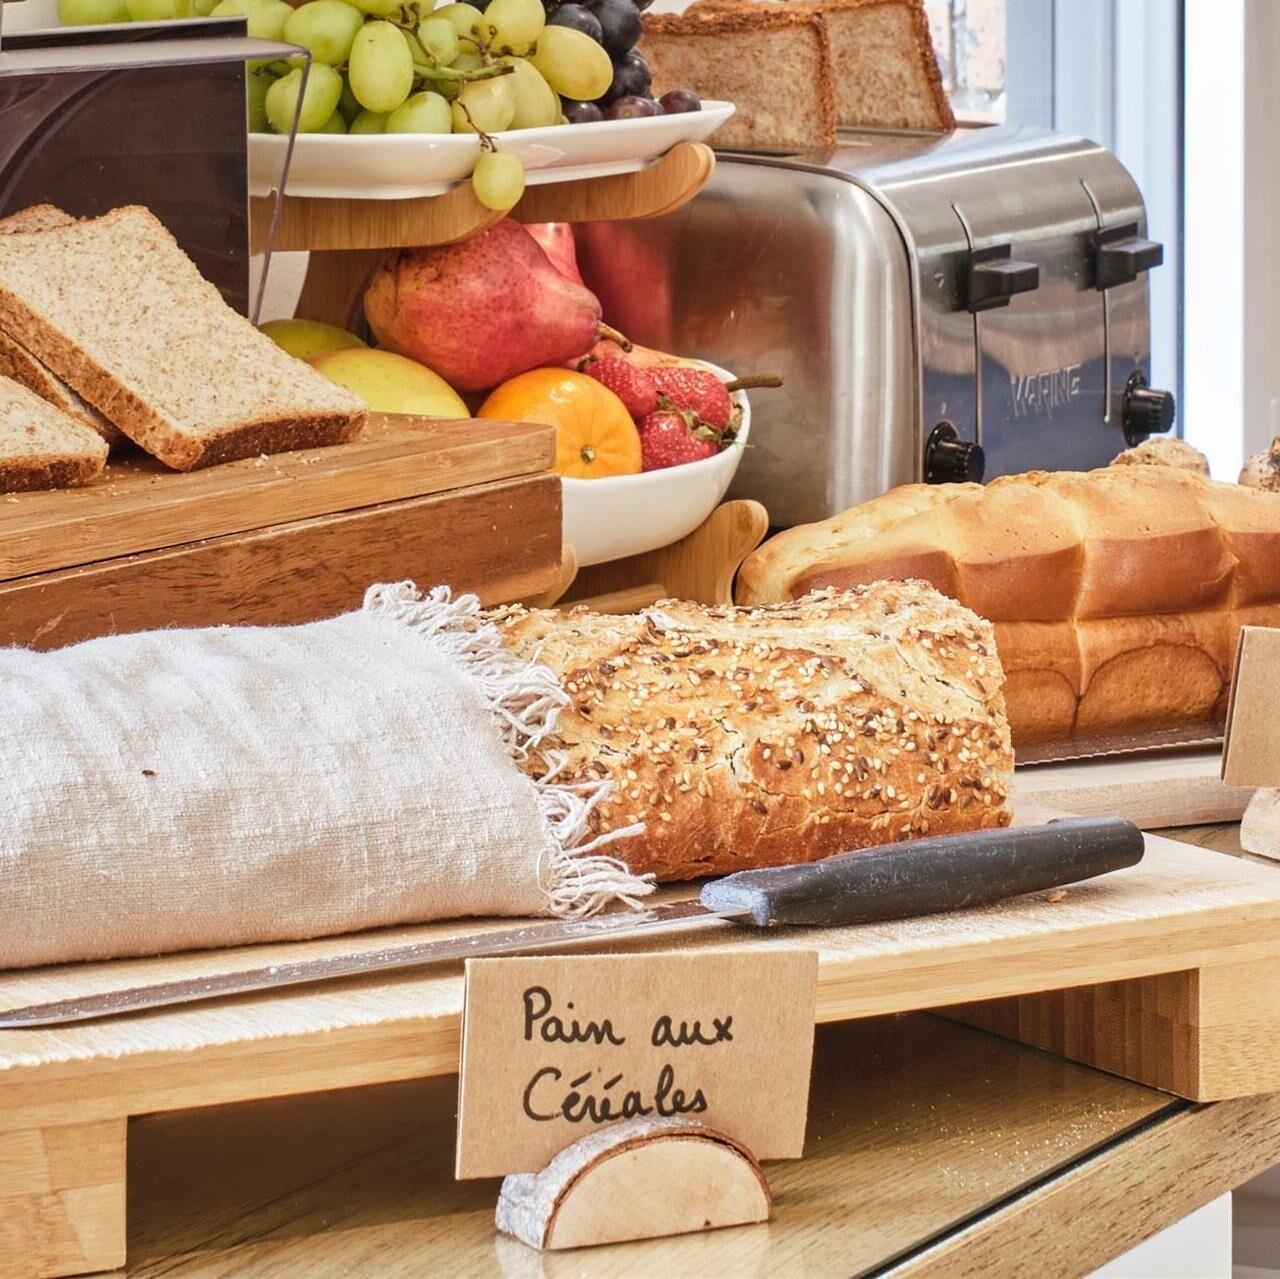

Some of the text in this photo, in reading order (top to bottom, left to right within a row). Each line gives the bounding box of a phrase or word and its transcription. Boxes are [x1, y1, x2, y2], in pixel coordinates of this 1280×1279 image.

[522, 985, 734, 1047] Pain aux
[522, 1063, 709, 1124] Céréales
